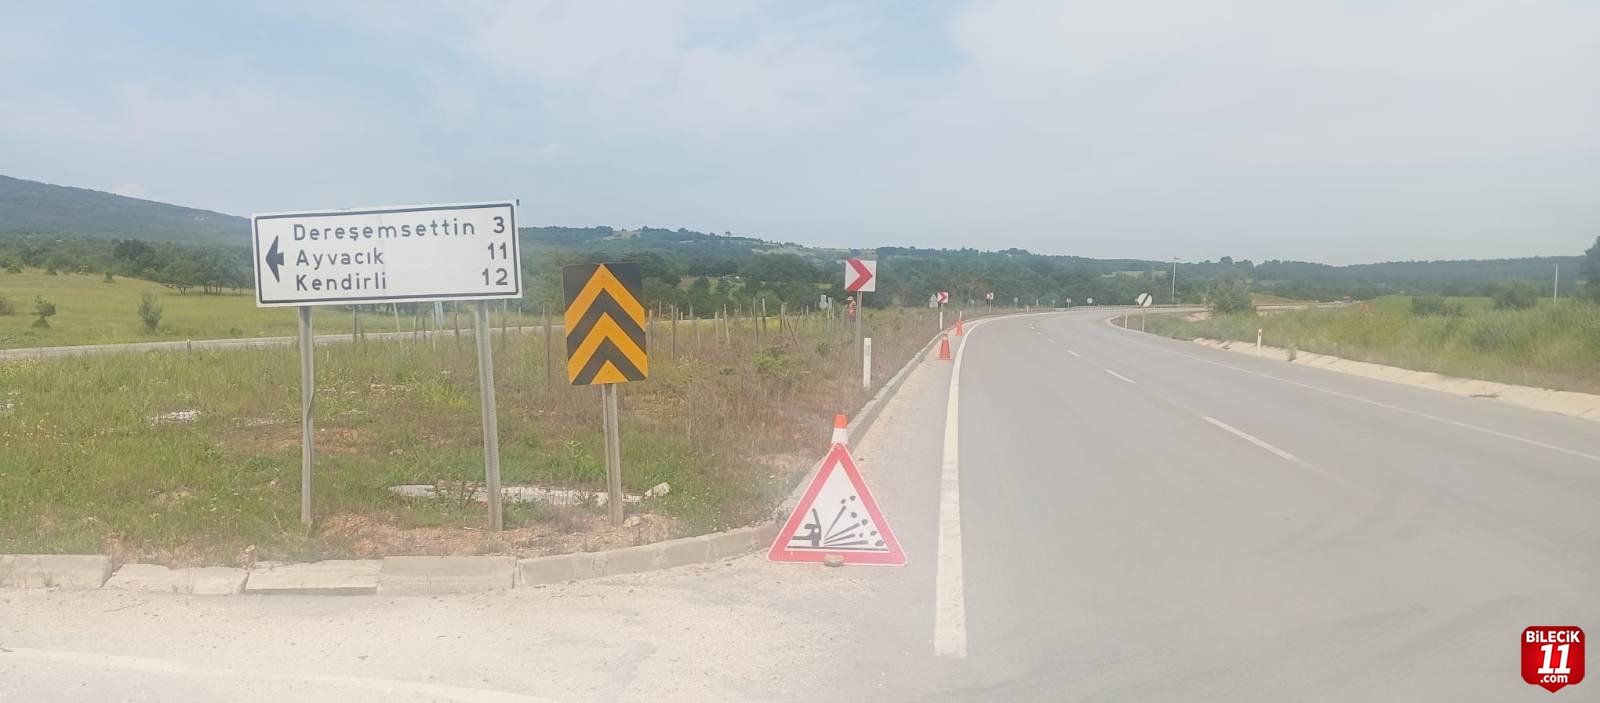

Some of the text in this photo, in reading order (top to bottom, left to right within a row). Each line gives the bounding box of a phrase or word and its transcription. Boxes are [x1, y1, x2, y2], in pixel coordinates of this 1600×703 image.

[293, 216, 506, 241] Dereşemsettin 3
[296, 242, 508, 270] Ayvacık 11
[296, 268, 508, 291] Kendirli 12
